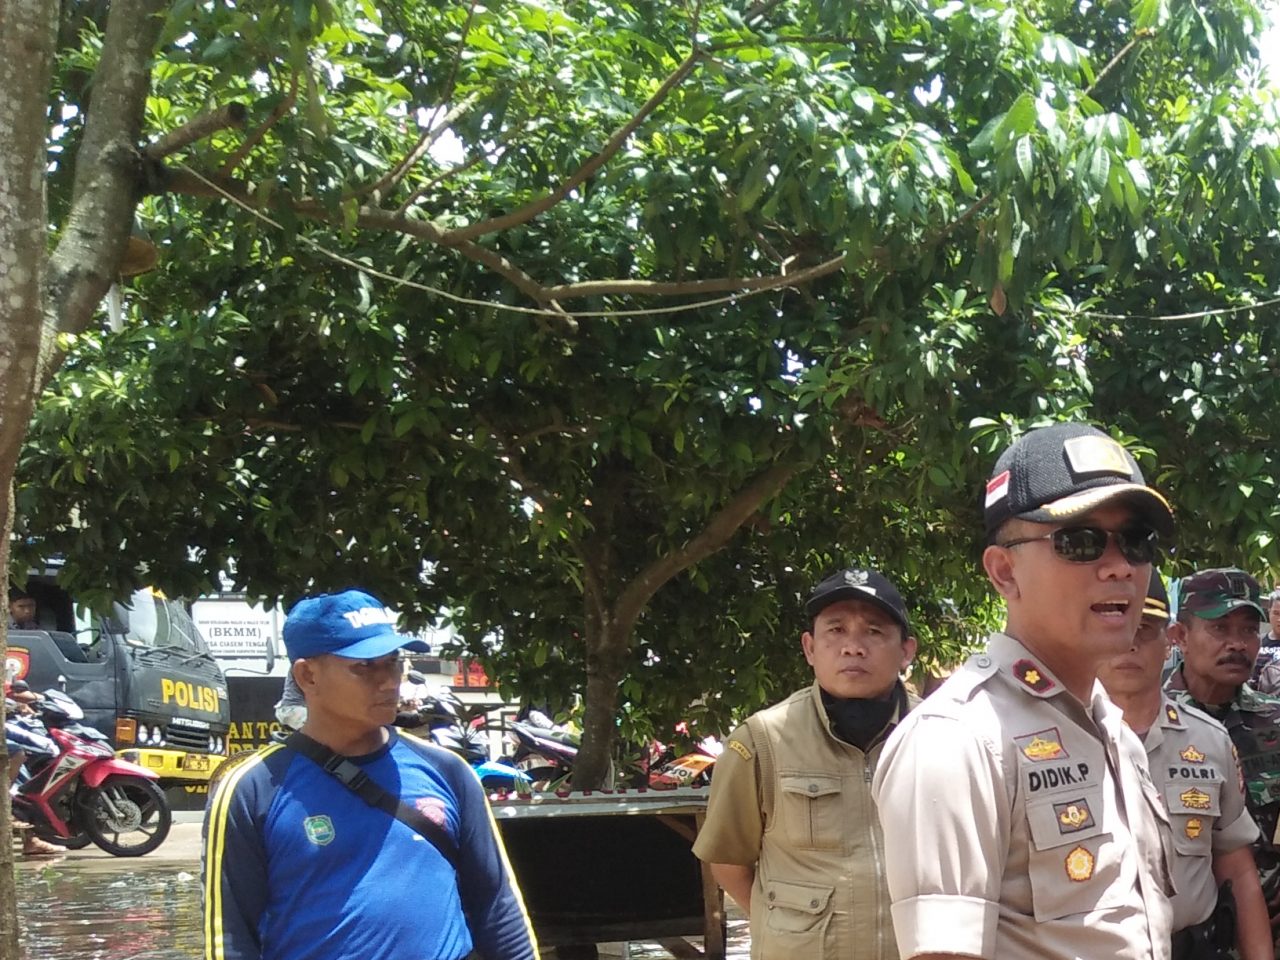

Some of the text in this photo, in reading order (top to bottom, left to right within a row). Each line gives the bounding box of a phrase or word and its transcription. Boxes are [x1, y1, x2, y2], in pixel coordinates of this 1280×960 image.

[209, 627, 262, 639] (BKMM)
[161, 678, 220, 714] POLISI
[229, 721, 284, 740] ANTO
[1029, 763, 1089, 792] DIDIK.P
[1169, 768, 1215, 779] POLRI
